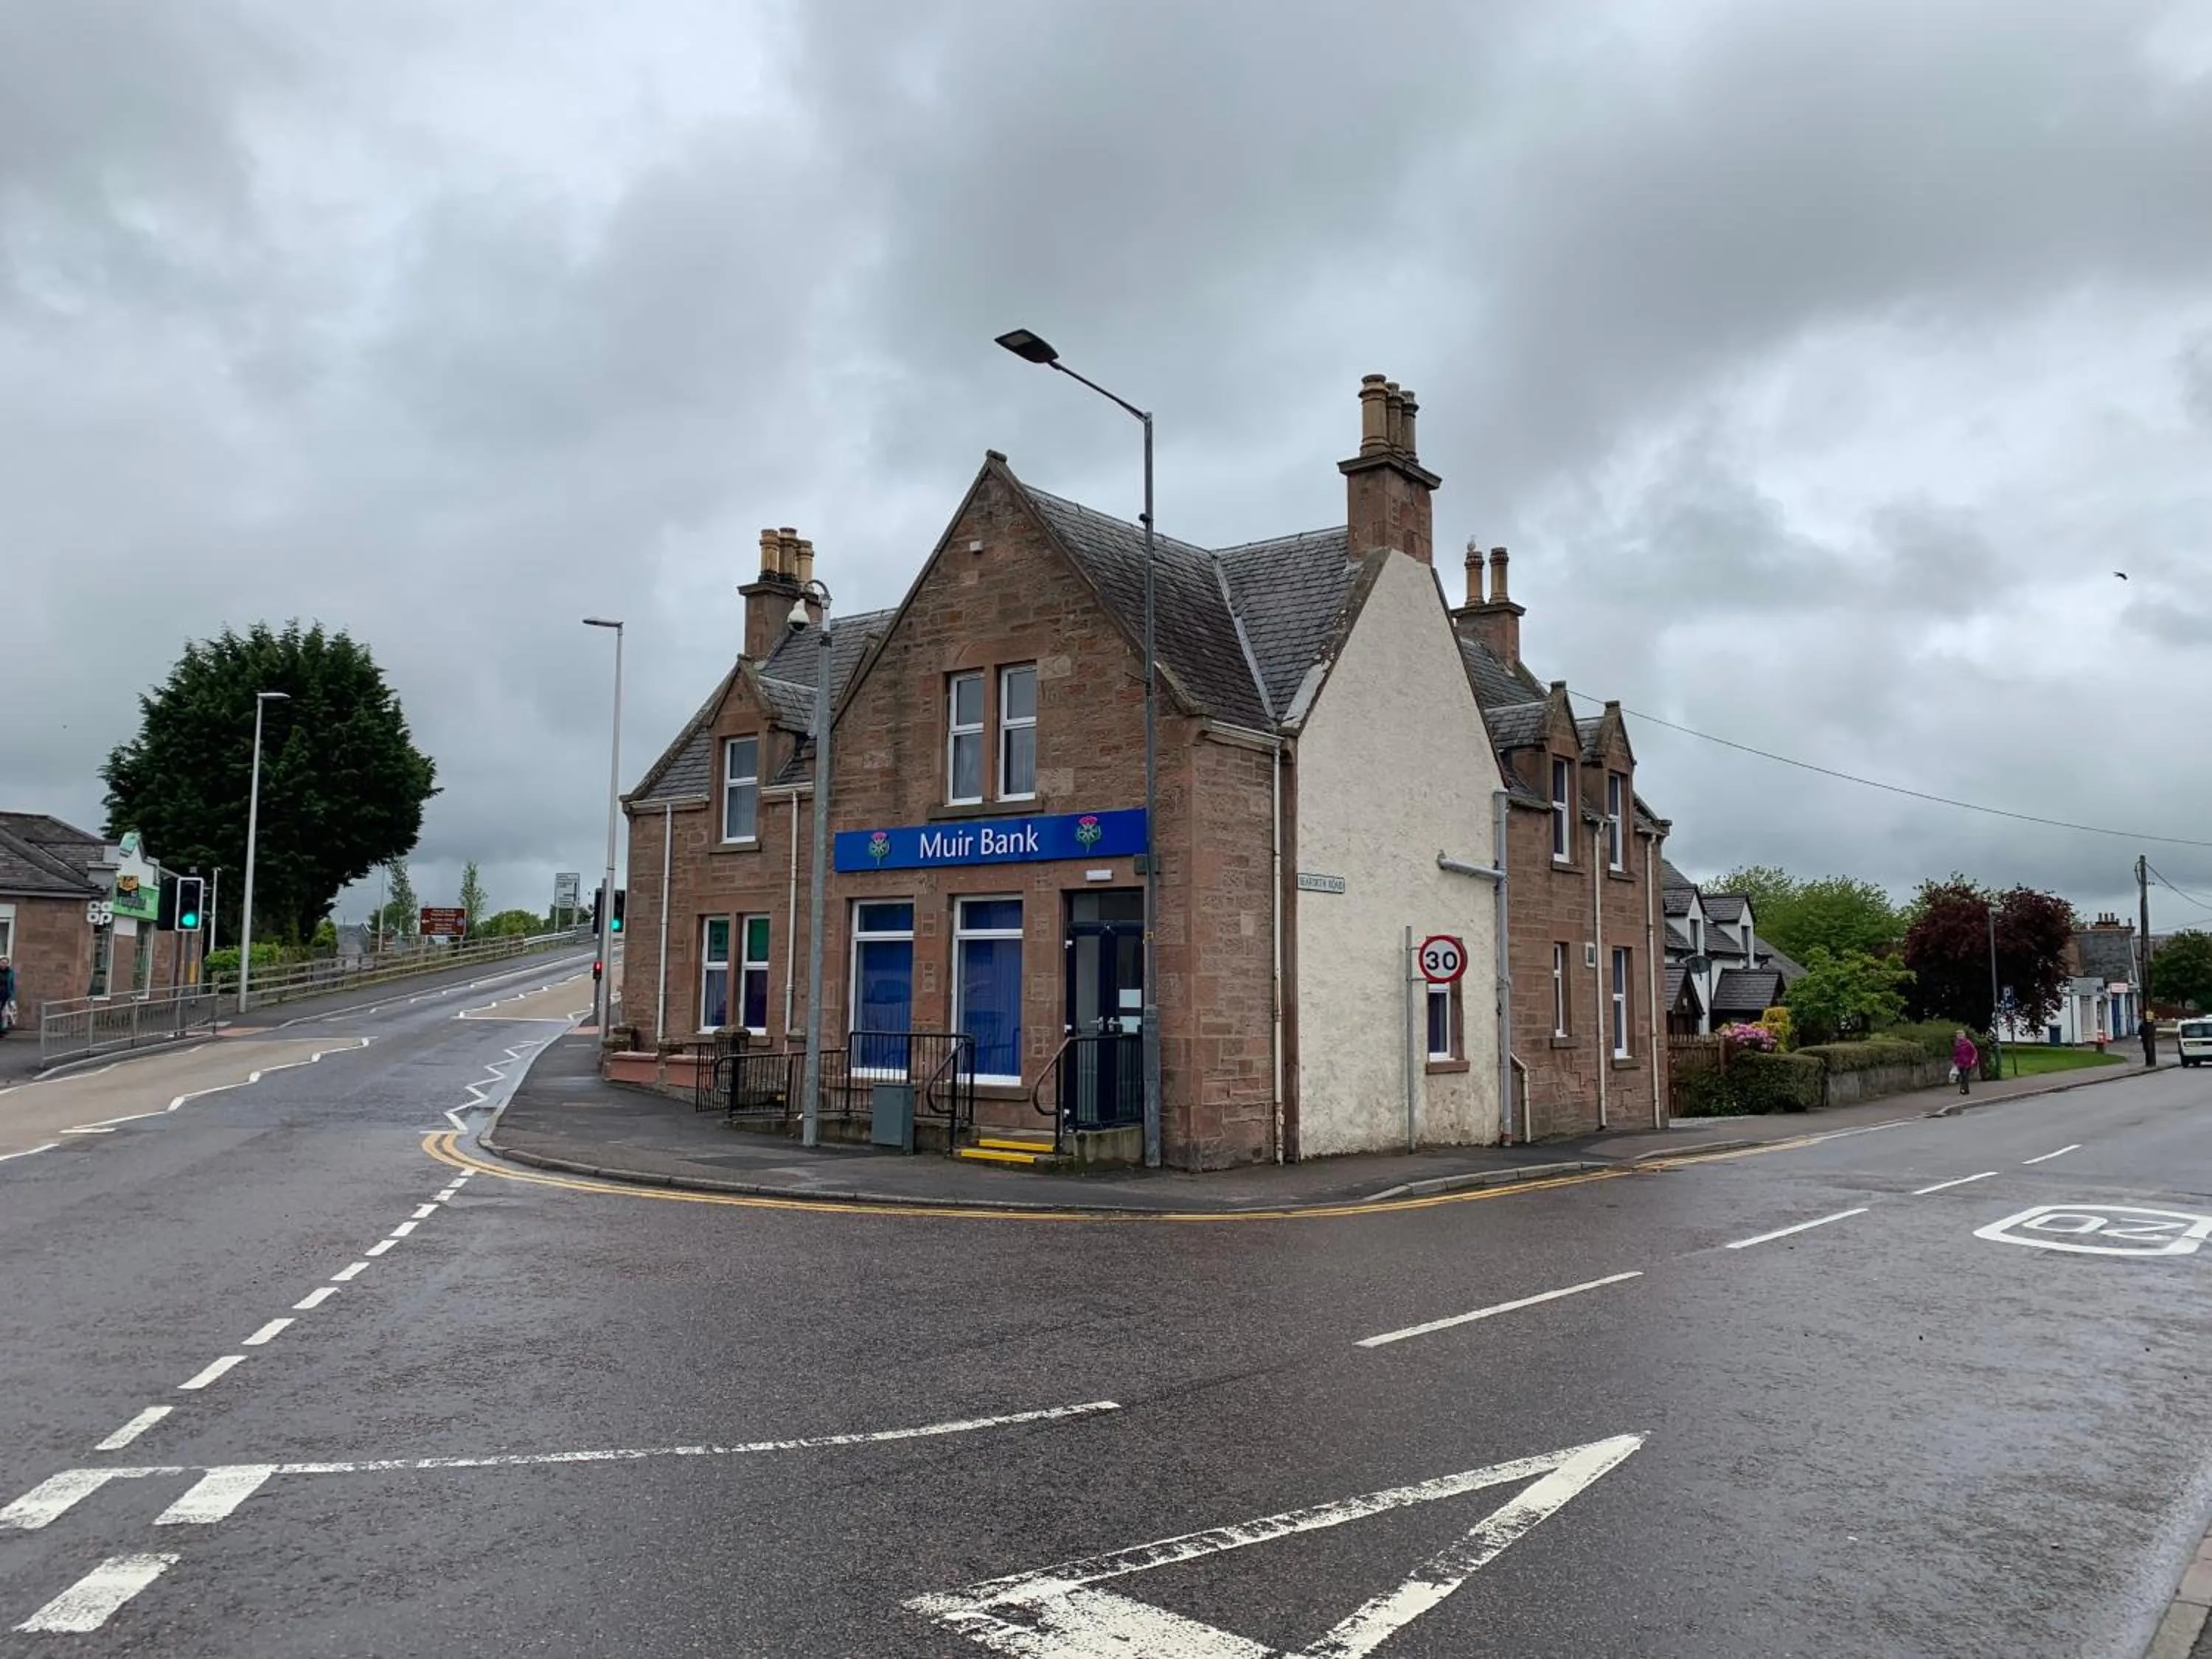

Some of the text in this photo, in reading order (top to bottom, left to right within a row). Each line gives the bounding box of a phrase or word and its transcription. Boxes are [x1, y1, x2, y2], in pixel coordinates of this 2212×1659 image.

[919, 824, 1038, 859] Muir Bank
[1426, 950, 1458, 971] 30
